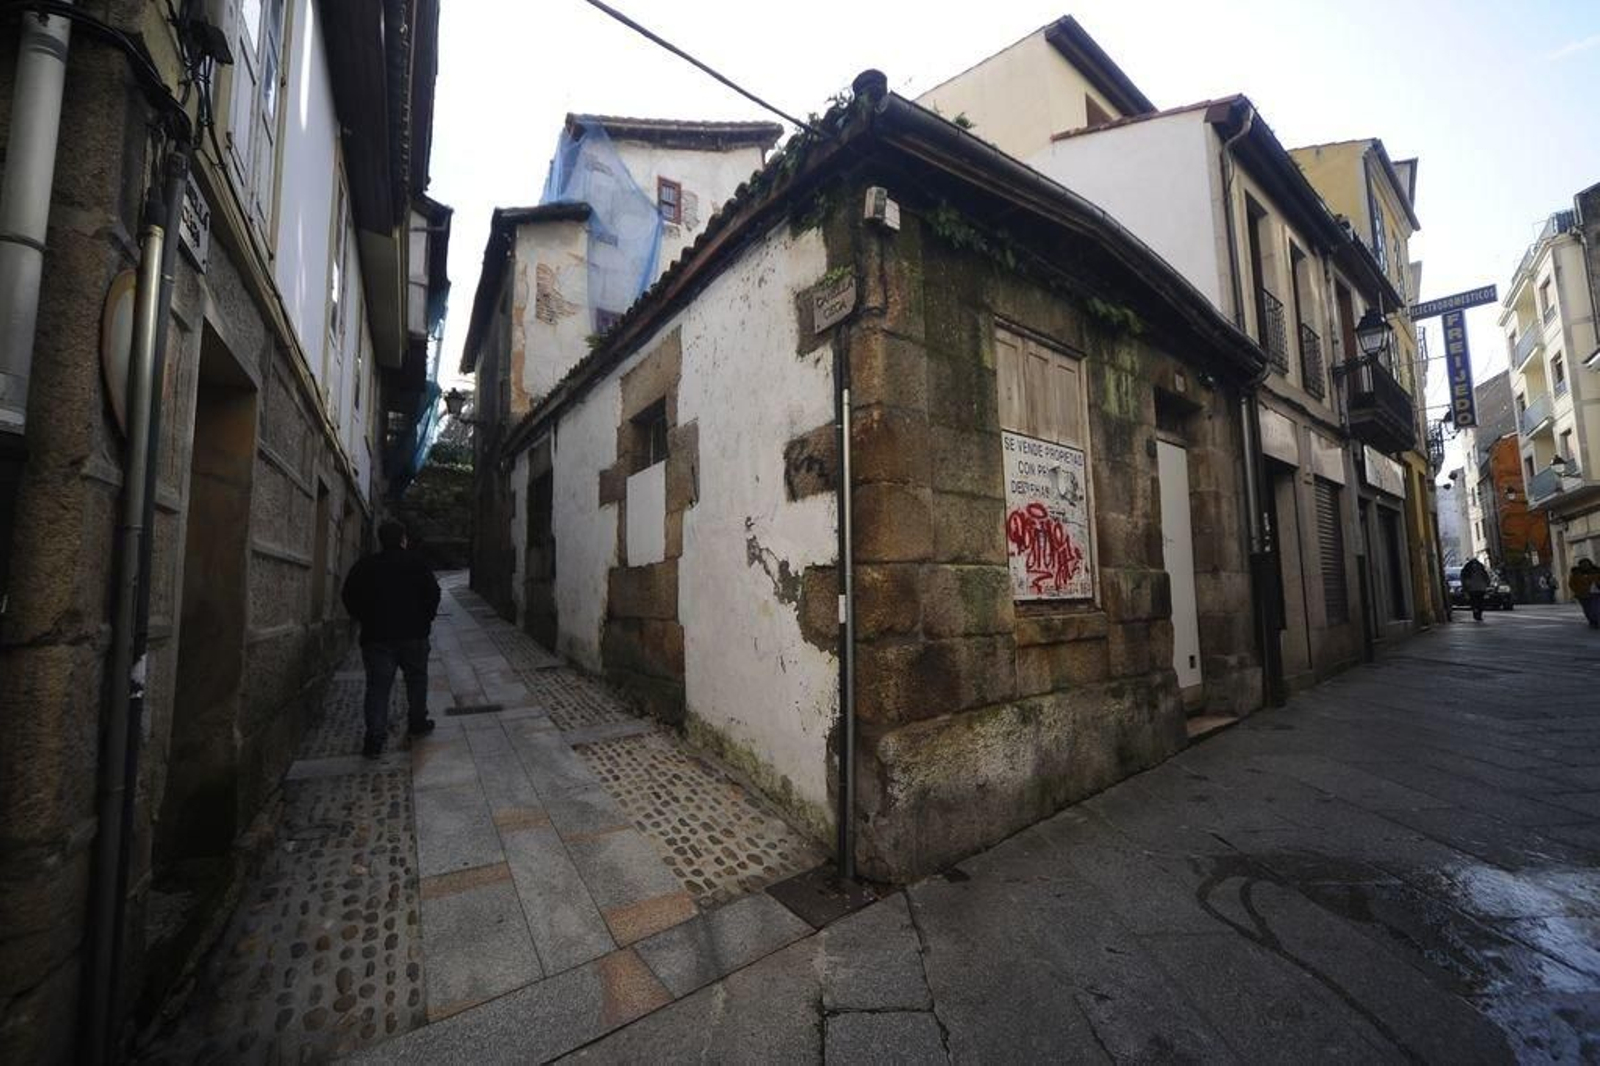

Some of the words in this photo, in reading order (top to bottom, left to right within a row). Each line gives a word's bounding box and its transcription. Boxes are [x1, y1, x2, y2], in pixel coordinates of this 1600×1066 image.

[1446, 313, 1473, 425] FREIJEDO
[1004, 436, 1015, 451] SE
[1017, 439, 1043, 458] VENDE
[1018, 460, 1035, 475] CON
